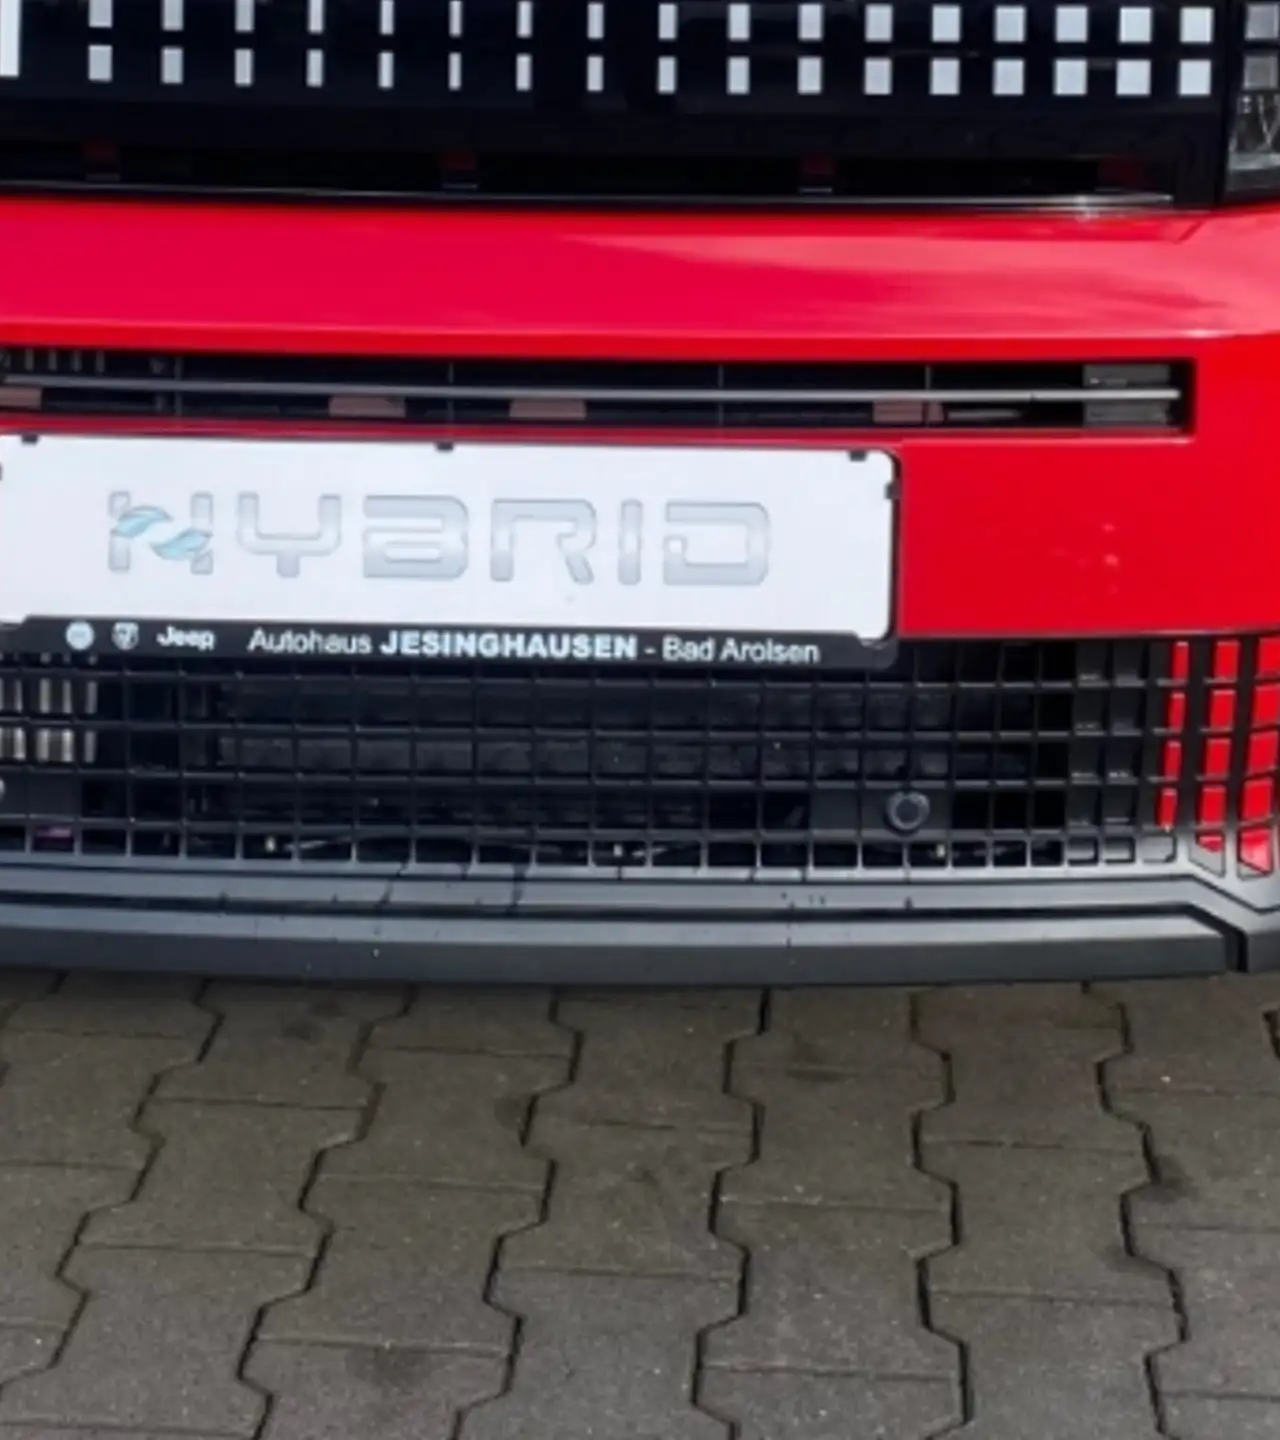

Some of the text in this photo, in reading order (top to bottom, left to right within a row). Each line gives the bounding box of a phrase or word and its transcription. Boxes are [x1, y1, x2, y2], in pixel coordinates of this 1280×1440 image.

[106, 489, 773, 587] HYBRID
[156, 626, 216, 651] Jeep
[247, 627, 373, 655] Autohaus
[379, 629, 638, 659] JESINGHAUSEN
[662, 637, 714, 662] Bad
[719, 638, 821, 665] Arolsen
